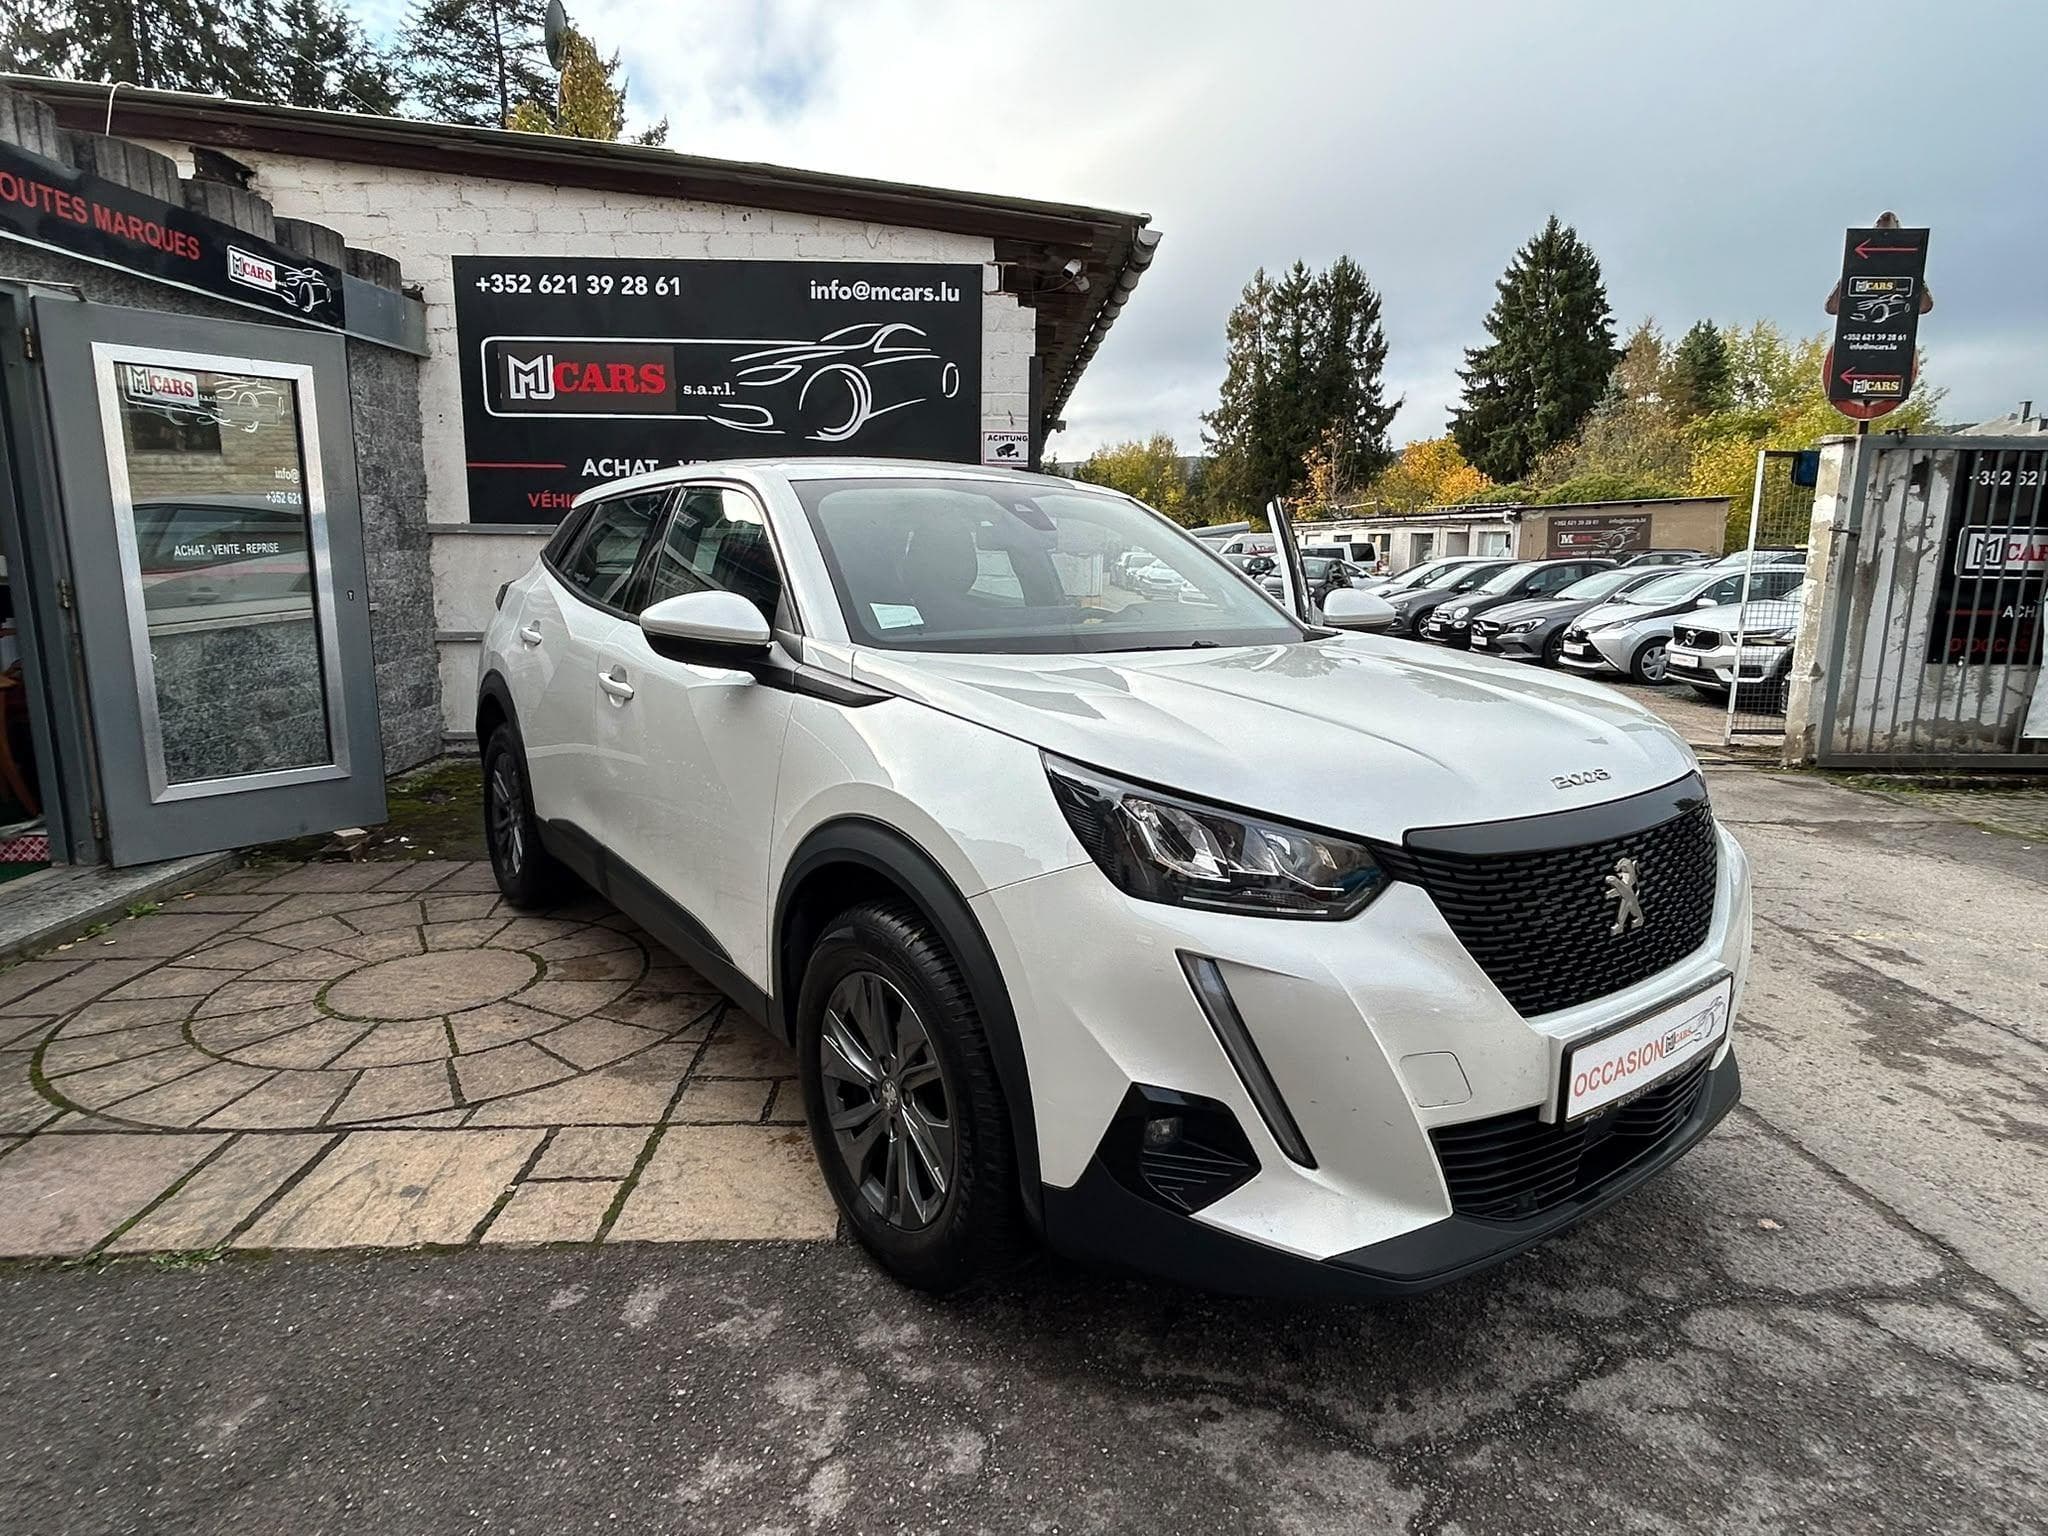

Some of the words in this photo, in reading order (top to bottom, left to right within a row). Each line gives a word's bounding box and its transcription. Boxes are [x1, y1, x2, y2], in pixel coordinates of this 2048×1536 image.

[92, 202, 201, 260] MARQUES
[243, 262, 273, 283] CARS
[475, 273, 532, 294] +352
[538, 274, 577, 294] 621
[586, 275, 614, 295] 39
[621, 276, 648, 295] 28
[655, 276, 680, 296] 61
[810, 279, 960, 302] info@mcars.lu
[1866, 281, 1894, 291] CARS
[150, 375, 194, 398] CARS
[552, 361, 667, 394] CARS
[683, 381, 736, 396] s.a.r.l.
[1866, 381, 1899, 391] CARS
[987, 434, 1028, 442] ACHTUNG
[581, 457, 659, 477] ACHAT
[265, 490, 287, 504] +352
[287, 492, 302, 505] 621
[174, 544, 205, 556] ACHAT
[211, 543, 241, 555] VENTE
[245, 542, 280, 554] REPRISE
[1550, 769, 1611, 790] 2008
[1573, 1038, 1665, 1098] OCCASION
